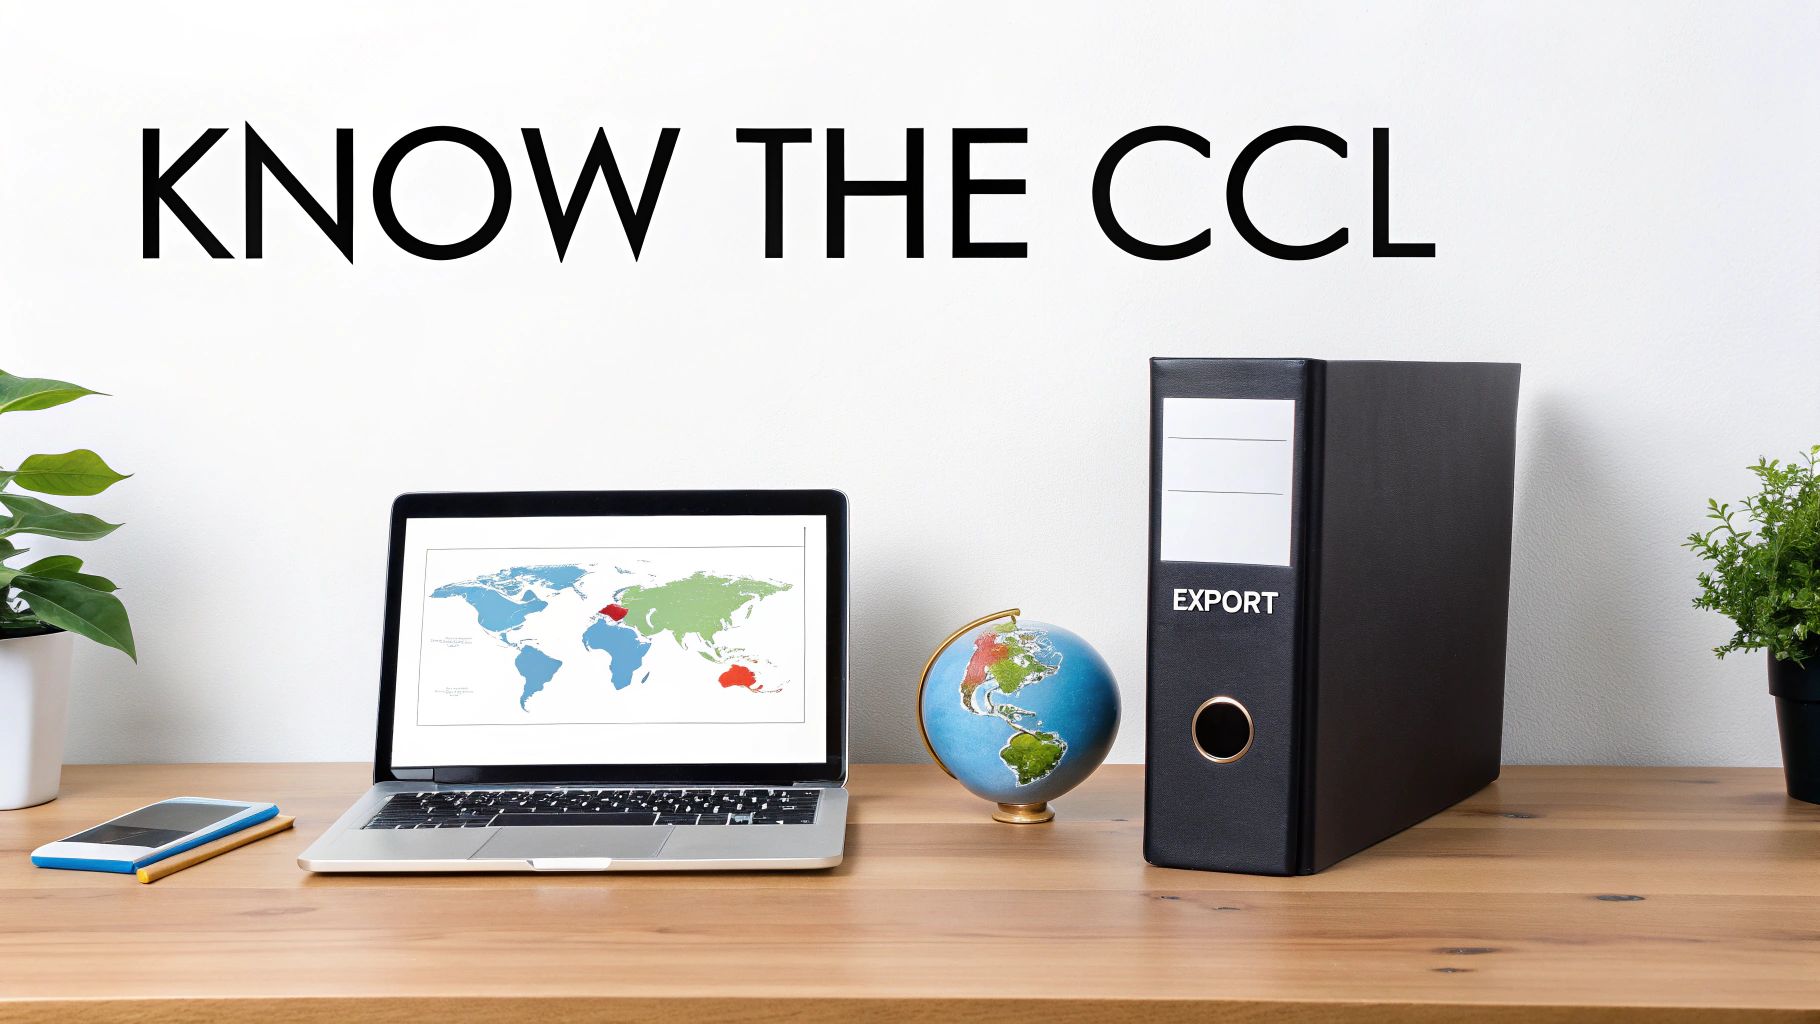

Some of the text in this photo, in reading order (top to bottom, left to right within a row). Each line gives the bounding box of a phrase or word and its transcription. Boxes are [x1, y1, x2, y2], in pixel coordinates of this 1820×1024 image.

[142, 121, 1436, 264] KNOW THE CCL
[1173, 588, 1279, 615] EXPORT
